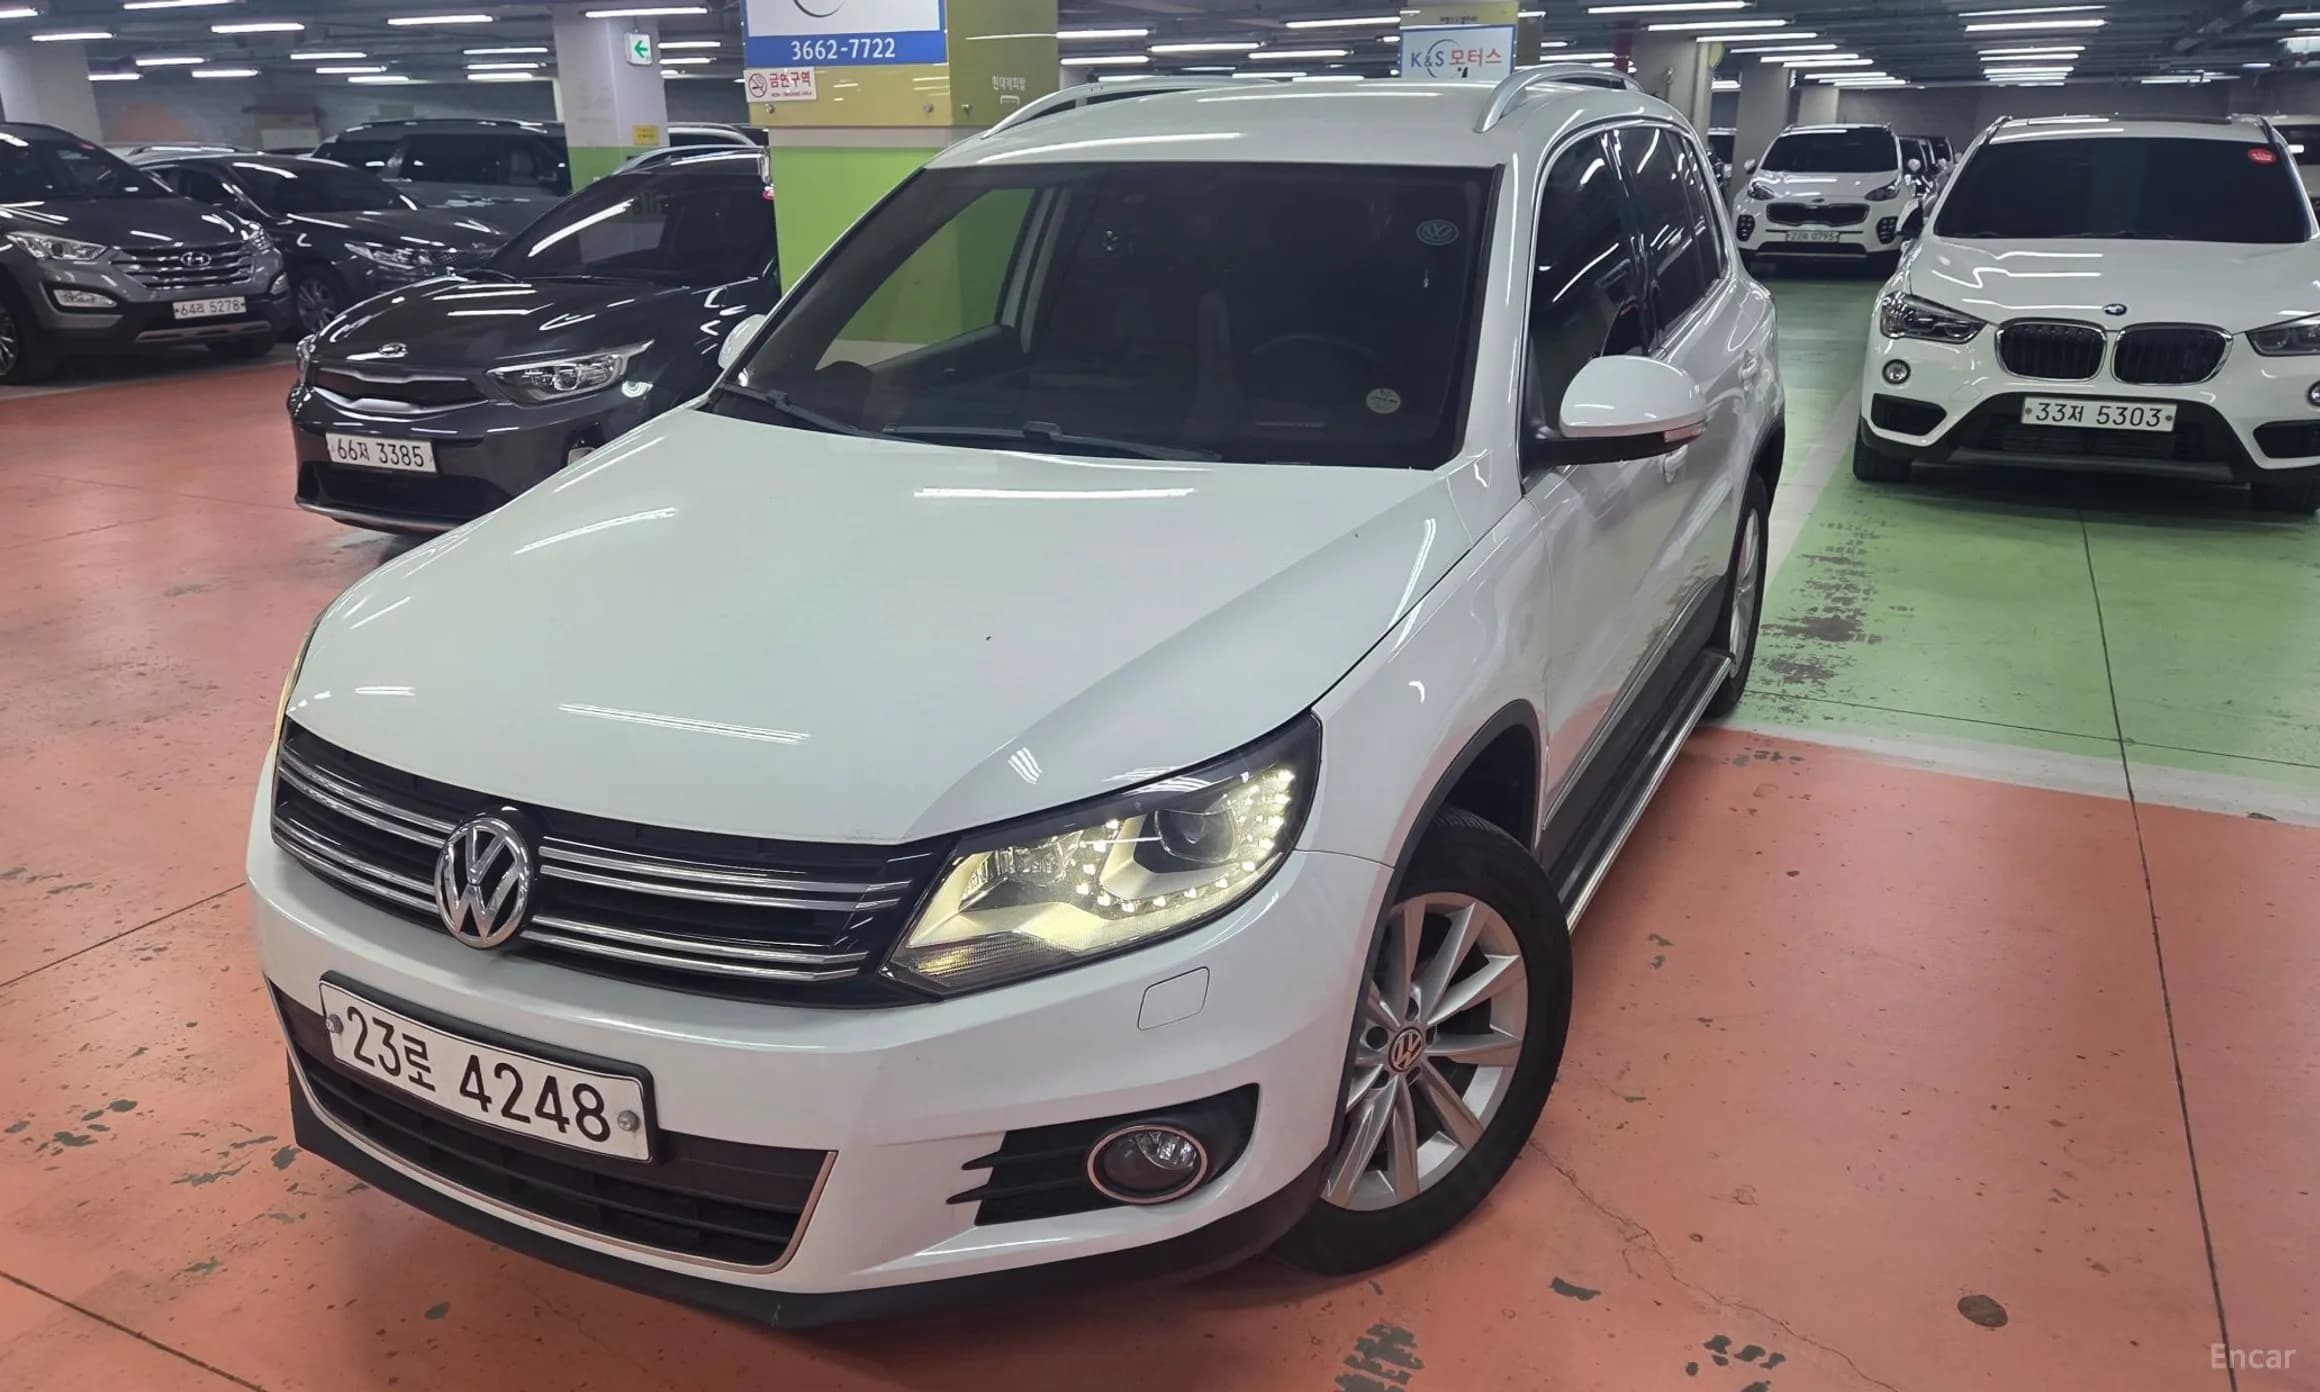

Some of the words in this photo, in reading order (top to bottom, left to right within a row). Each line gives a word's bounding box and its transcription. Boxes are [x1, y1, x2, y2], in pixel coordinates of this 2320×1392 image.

[790, 37, 896, 61] 3662-7722
[1411, 50, 1445, 68] K&S
[1448, 48, 1502, 66] 모터스
[769, 71, 811, 88] 금연구역
[209, 299, 240, 313] 5278
[2035, 402, 2085, 423] 33저
[2095, 405, 2163, 428] 5303
[376, 442, 424, 467] 3385
[346, 1005, 436, 1091] 23로
[459, 1054, 611, 1142] 4248
